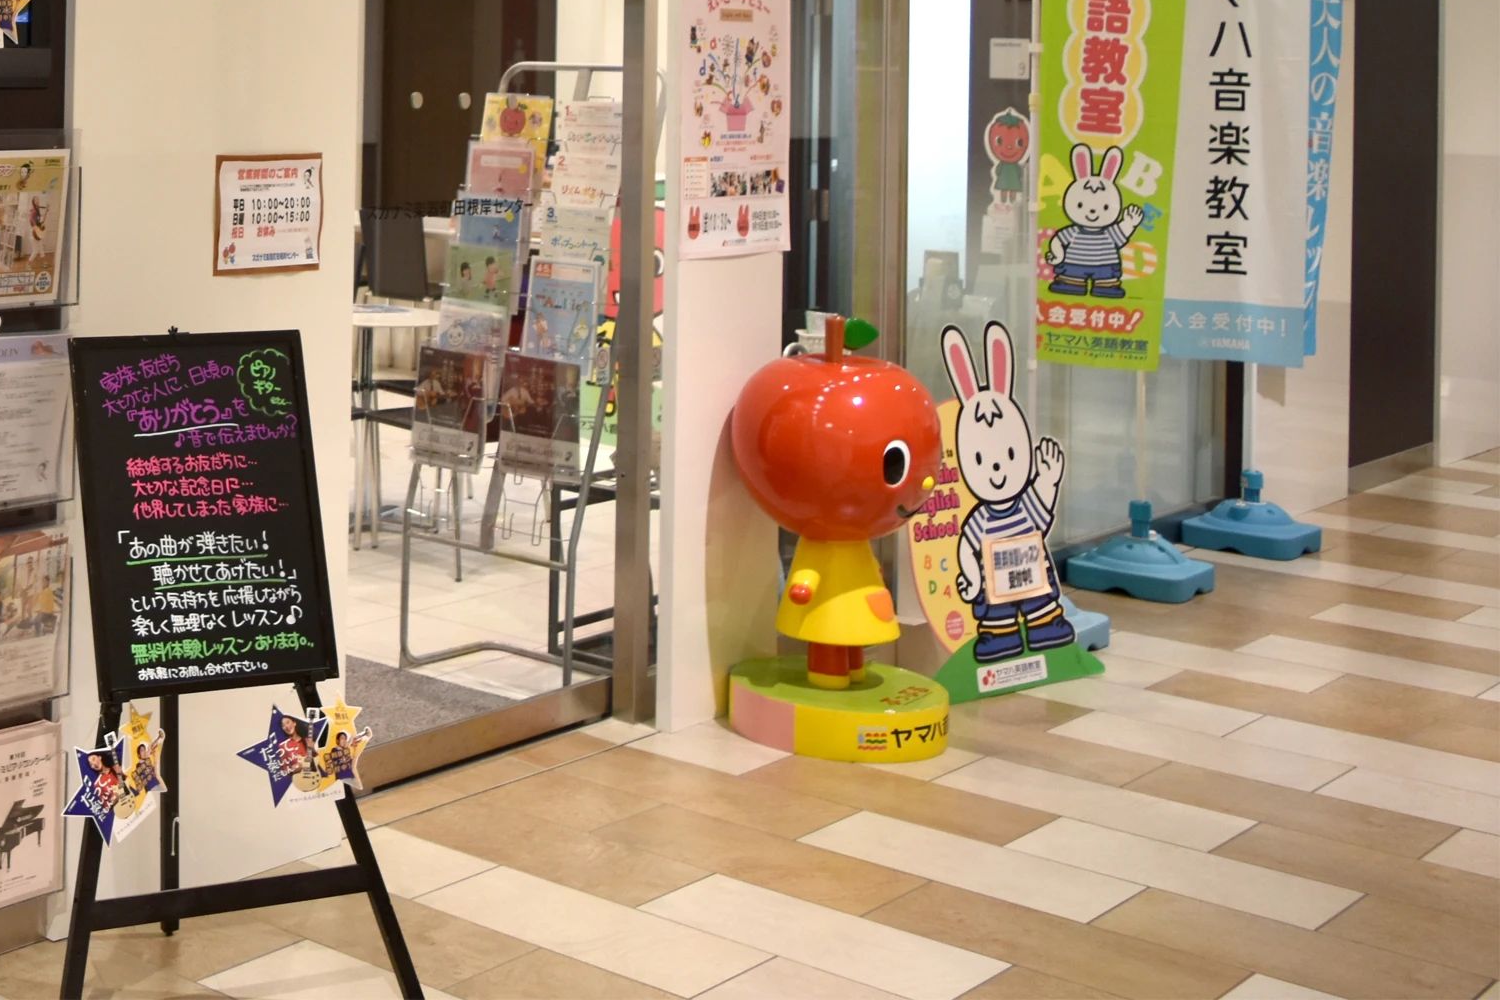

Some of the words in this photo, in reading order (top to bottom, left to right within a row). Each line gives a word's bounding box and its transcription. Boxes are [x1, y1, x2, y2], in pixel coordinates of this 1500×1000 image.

[1045, 332, 1149, 351] ヤマハ英語教室
[250, 360, 276, 382] ピアノ
[252, 379, 282, 395] ギター
[914, 515, 960, 543] School
